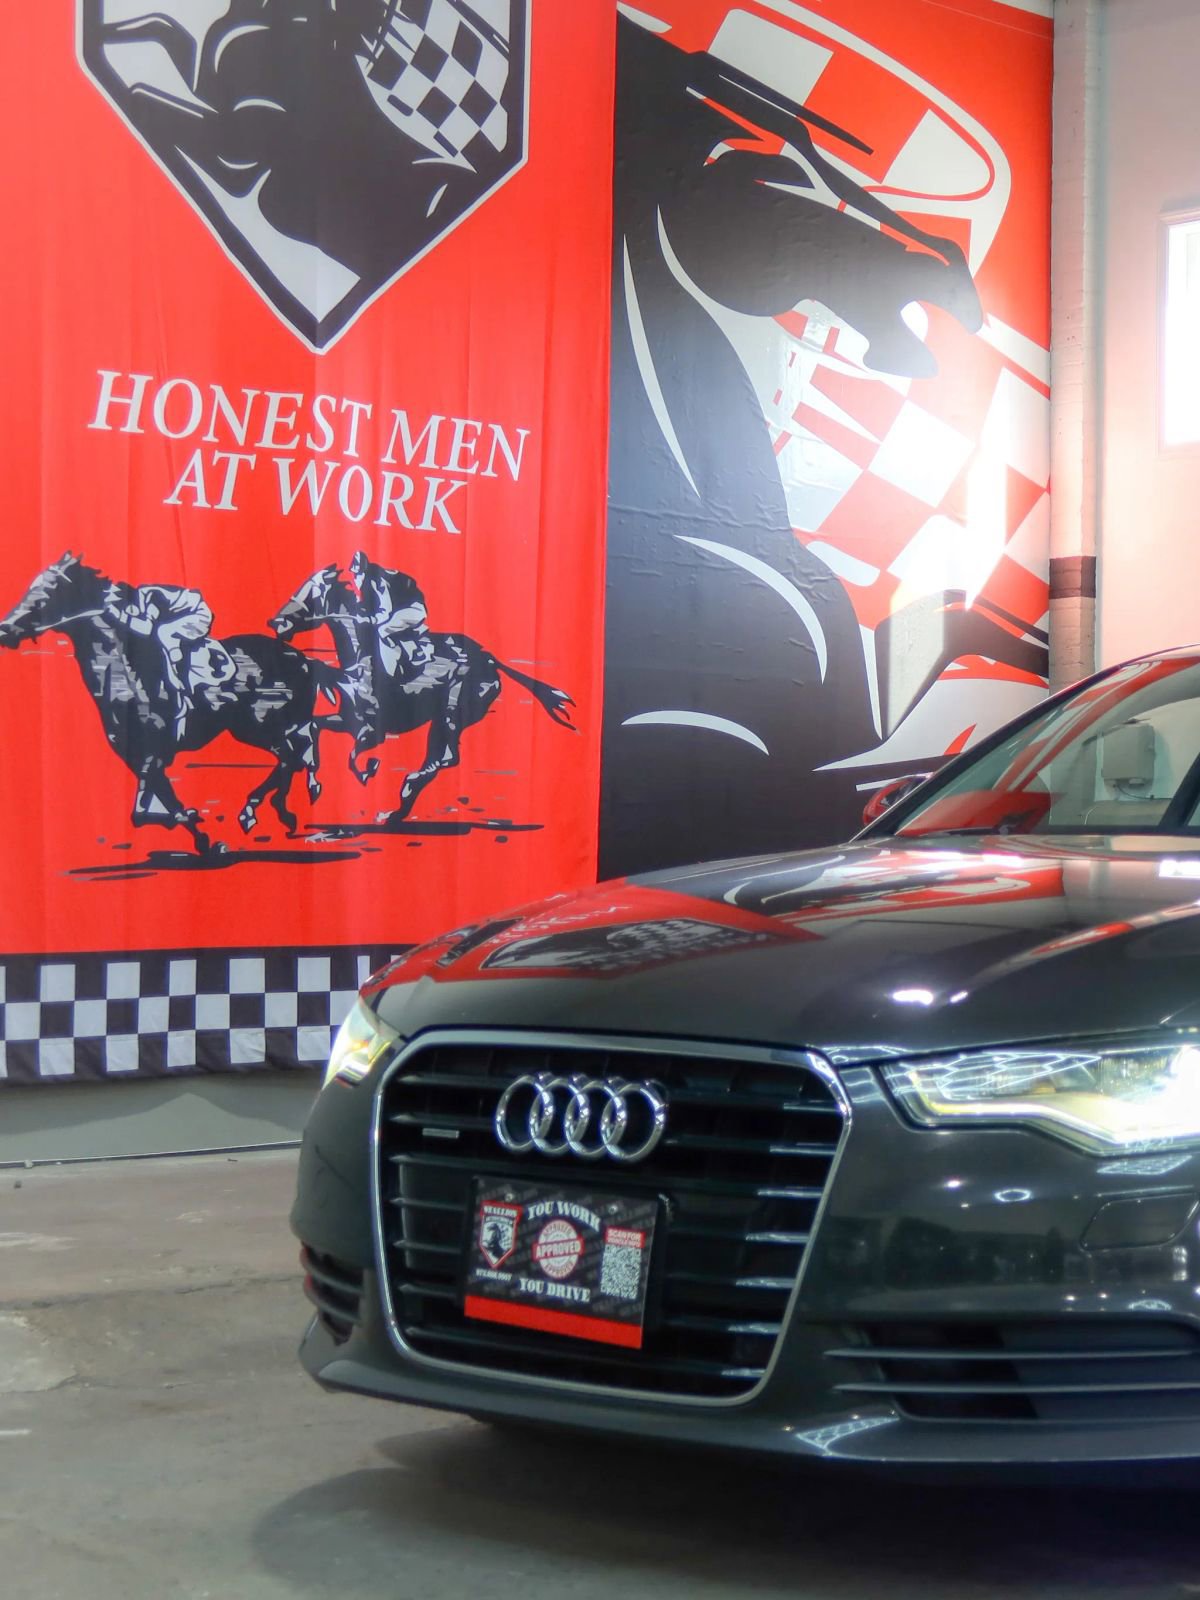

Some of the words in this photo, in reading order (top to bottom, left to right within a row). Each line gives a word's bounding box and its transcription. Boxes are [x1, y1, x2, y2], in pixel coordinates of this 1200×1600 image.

[87, 369, 372, 457] HONEST
[381, 408, 531, 482] MEN
[163, 448, 257, 511] AT
[271, 456, 469, 534] WORK
[528, 1201, 553, 1220] YOU
[556, 1201, 601, 1232] WORK
[536, 1240, 581, 1258] APPROVED
[519, 1278, 544, 1294] YOU
[547, 1283, 590, 1302] DRIVE
